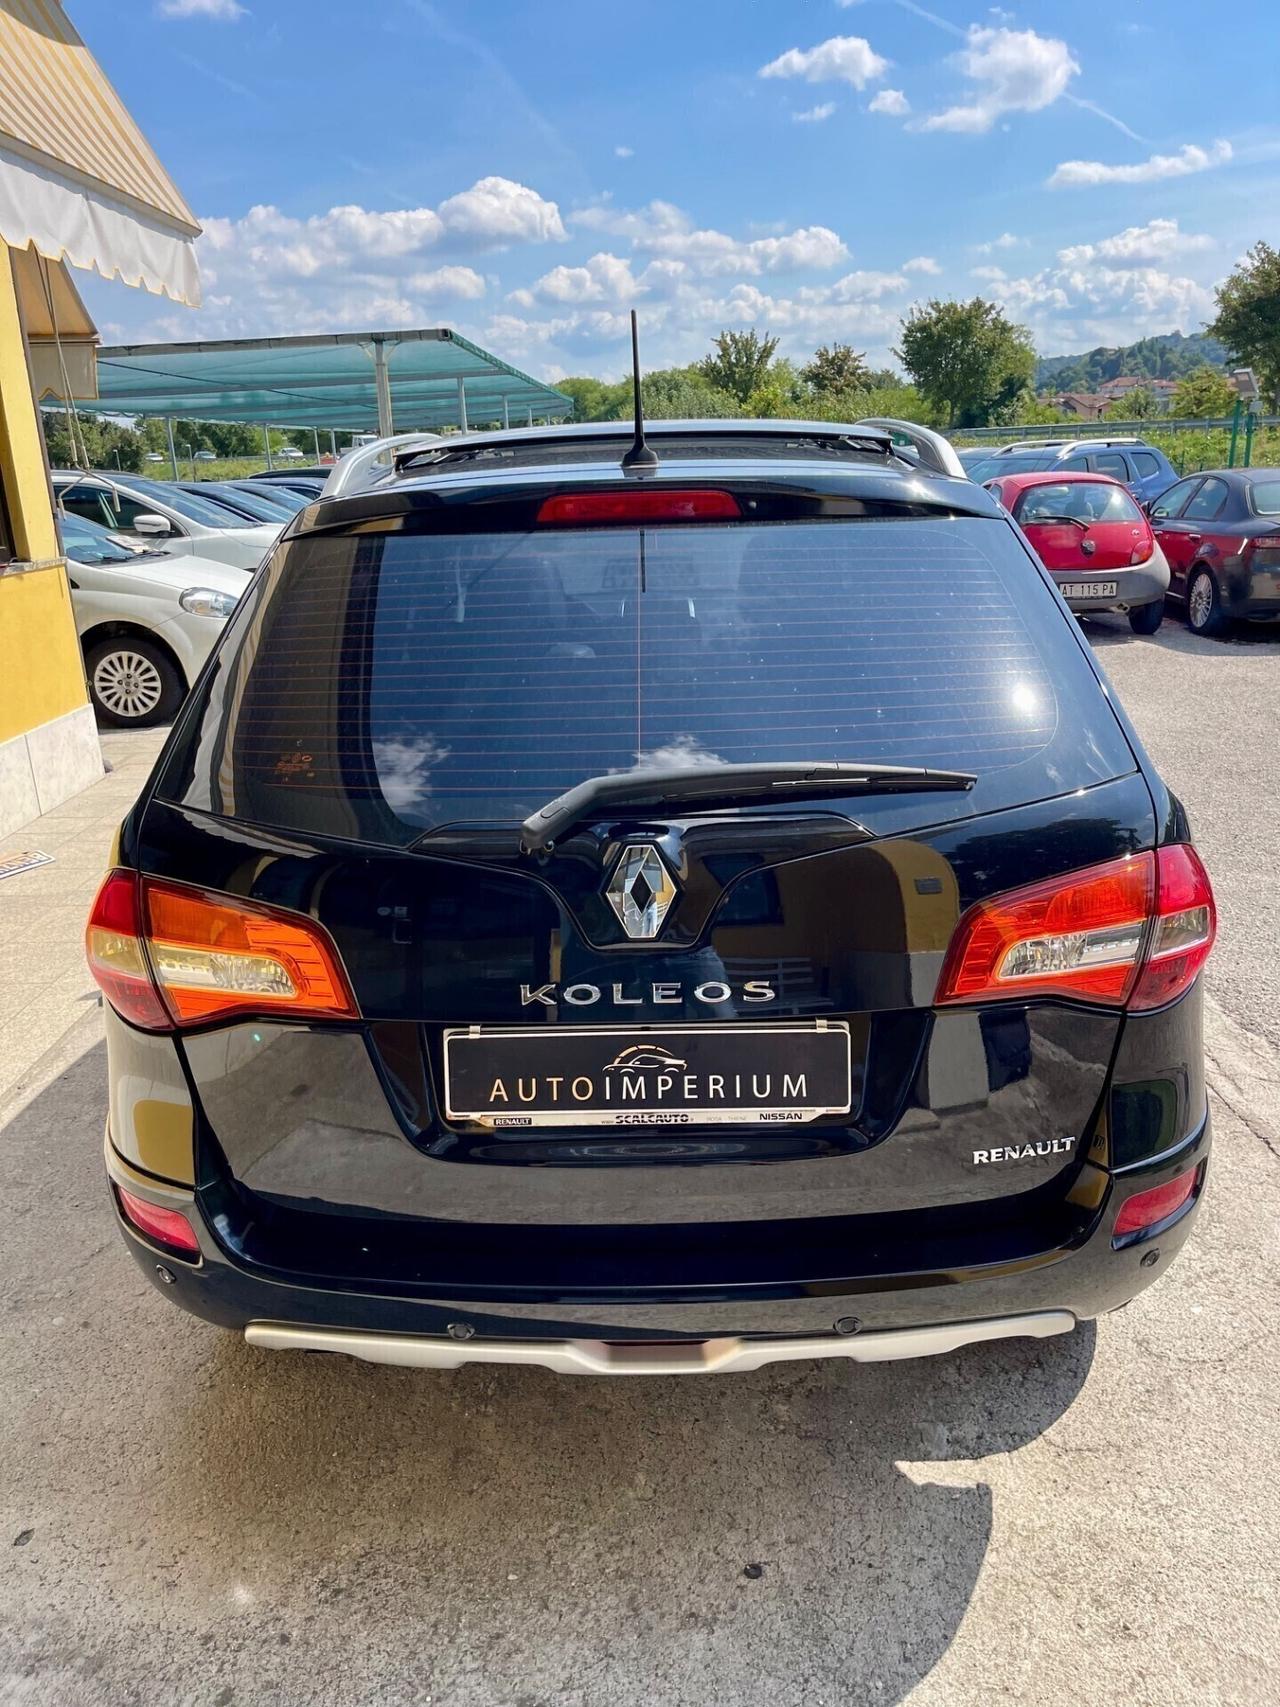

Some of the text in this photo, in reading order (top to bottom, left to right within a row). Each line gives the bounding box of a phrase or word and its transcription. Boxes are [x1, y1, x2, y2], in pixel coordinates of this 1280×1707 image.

[1062, 584, 1115, 596] AT 115 PA
[519, 980, 776, 1006] KOLEOS
[489, 1073, 808, 1103] AUTOIMPERIUM
[495, 1118, 530, 1126] RENAULT
[759, 1113, 803, 1121] NISSAN
[972, 1136, 1076, 1165] RENAULT
